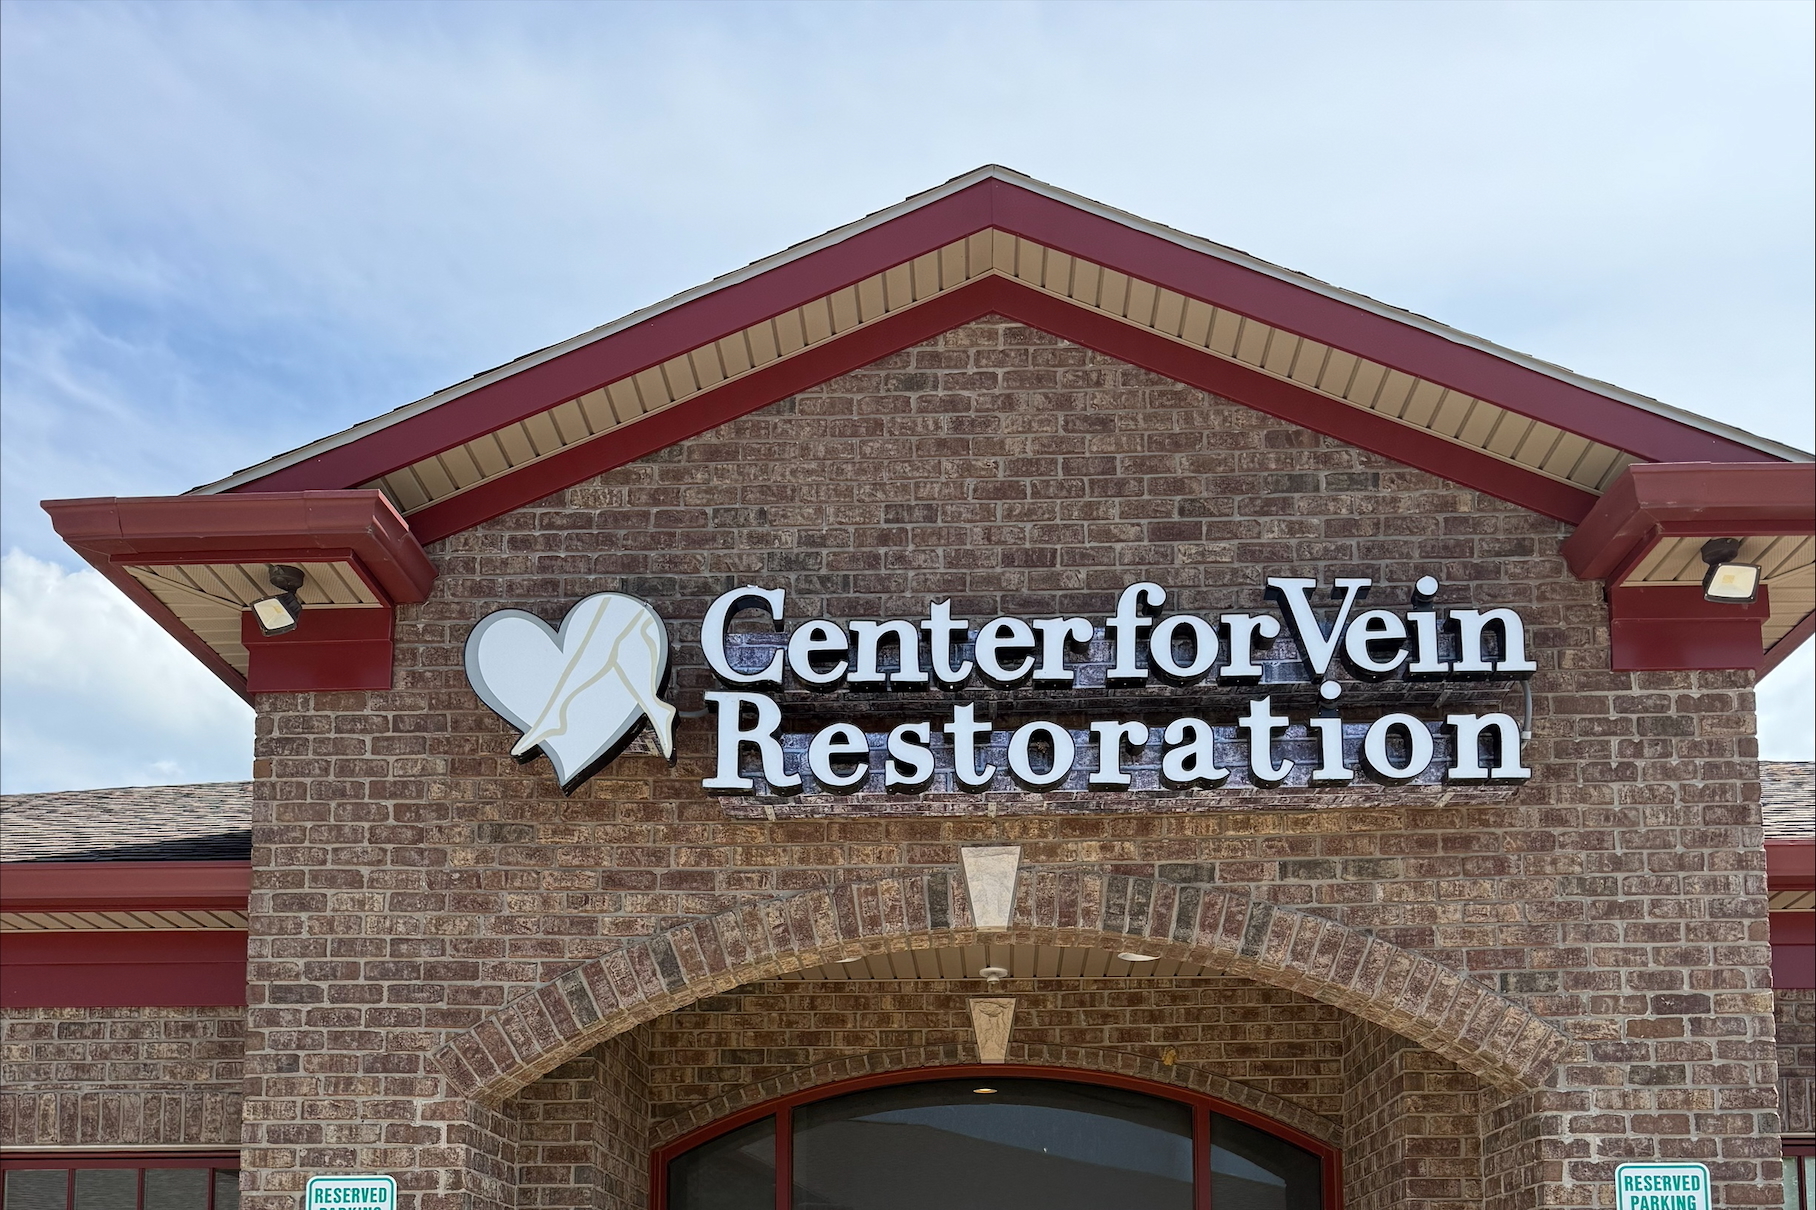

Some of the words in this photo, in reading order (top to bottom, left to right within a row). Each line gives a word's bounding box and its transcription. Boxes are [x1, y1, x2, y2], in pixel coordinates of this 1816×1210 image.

[701, 584, 1095, 685] Center
[1105, 580, 1281, 680] for
[1265, 575, 1538, 676] Vein
[702, 680, 1533, 794] Restoration
[314, 1187, 388, 1204] RESERVED
[1624, 1175, 1701, 1192] RESERVED
